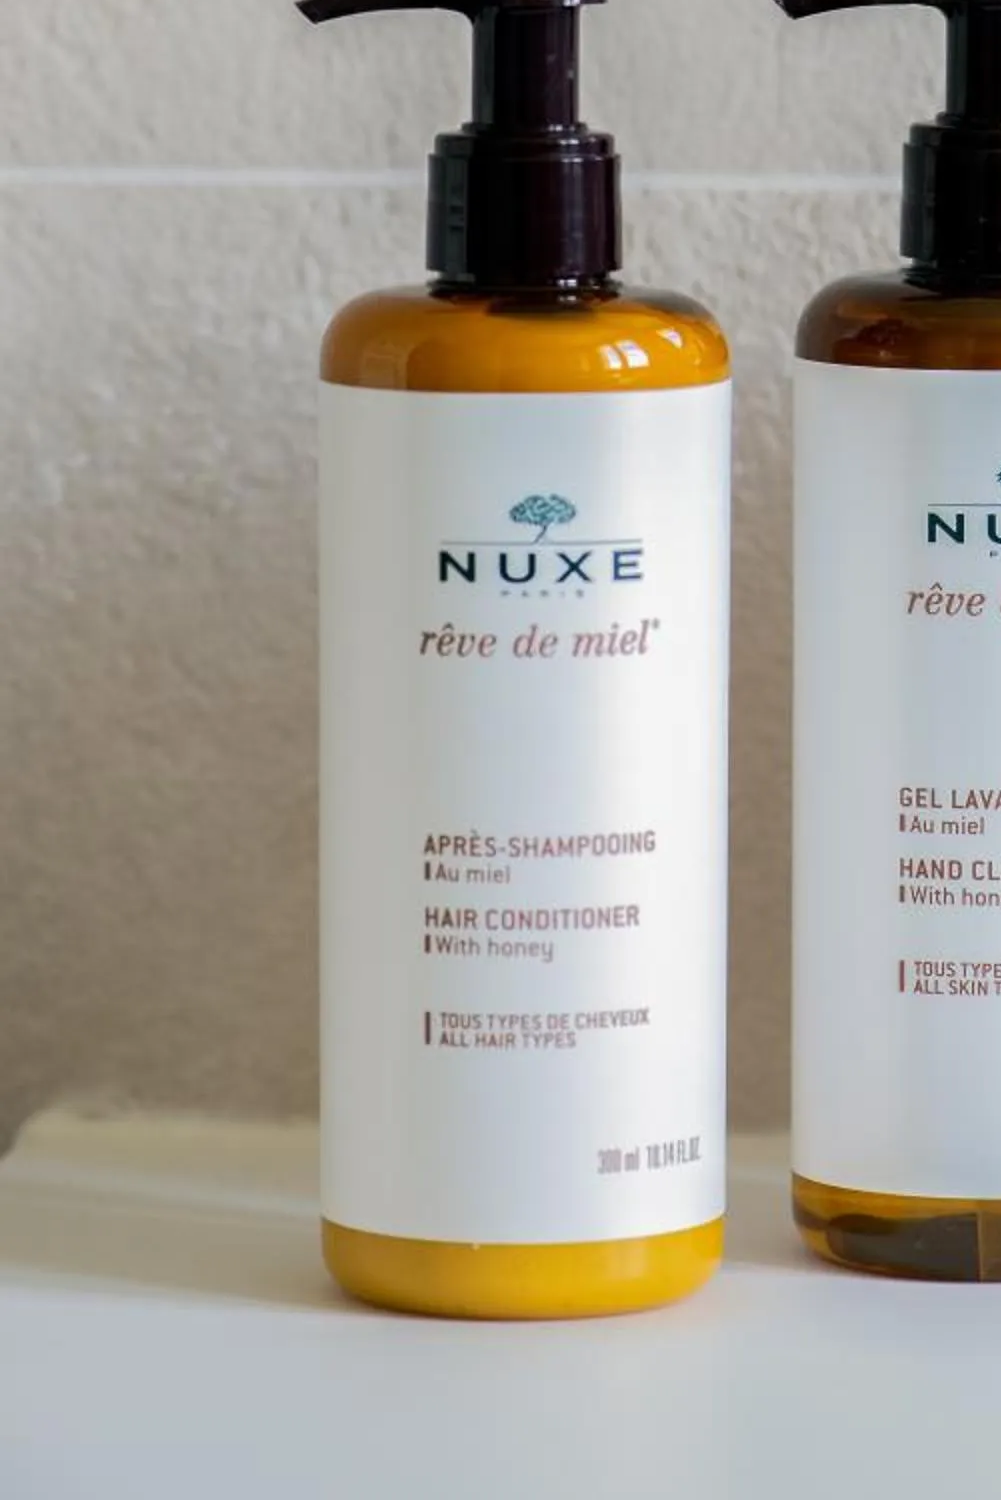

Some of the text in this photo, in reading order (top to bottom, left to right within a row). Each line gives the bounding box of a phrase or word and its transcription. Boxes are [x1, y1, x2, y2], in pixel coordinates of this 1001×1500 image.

[439, 549, 644, 583] NUXE
[907, 582, 986, 617] rêve
[419, 622, 497, 658] rêve
[513, 624, 559, 658] de
[899, 786, 943, 809] GEL
[910, 815, 985, 835] Au miel
[424, 829, 656, 858] APRÈS-SHAMPOOING
[435, 863, 511, 884] Au miel
[900, 857, 963, 881] HAND
[910, 886, 955, 906] With
[425, 905, 640, 932] HAIR CONDITIONER
[435, 936, 554, 963] With honey
[914, 961, 956, 977] TOUS
[913, 980, 944, 995] ALL
[949, 980, 989, 996] SKIN
[440, 1008, 650, 1031] TOUS TYPES DE CHEVEUX
[440, 1032, 576, 1049] ALL HAIR TYPES
